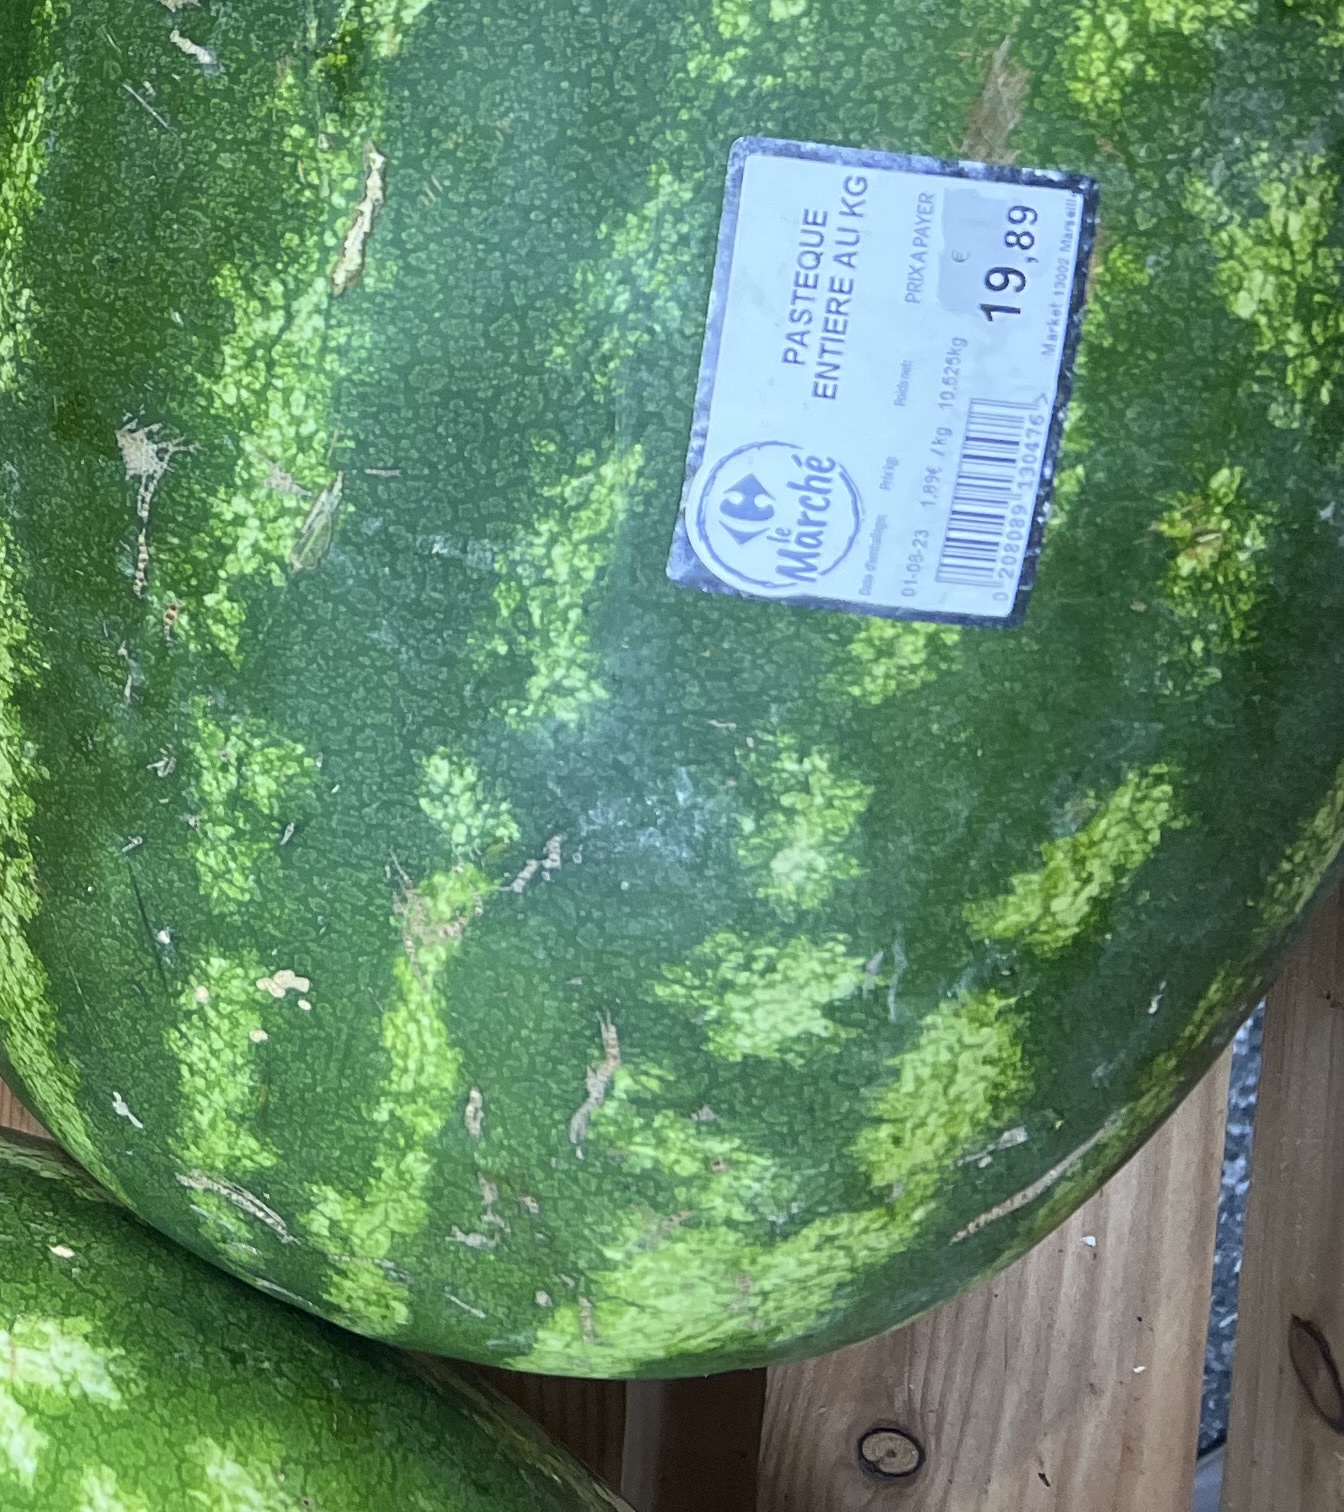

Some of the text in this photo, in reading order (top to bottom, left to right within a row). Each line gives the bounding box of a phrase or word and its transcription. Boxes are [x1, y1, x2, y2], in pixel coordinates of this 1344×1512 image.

[780, 207, 828, 366] PASTEQUE
[810, 174, 868, 400] ENTIERE AU KG
[903, 191, 935, 304] PRIX A PAYER
[978, 204, 1038, 322] 19,89
[1040, 301, 1062, 356] Market
[765, 526, 792, 544] le
[774, 453, 837, 583] Marché
[996, 501, 1028, 581] 208089
